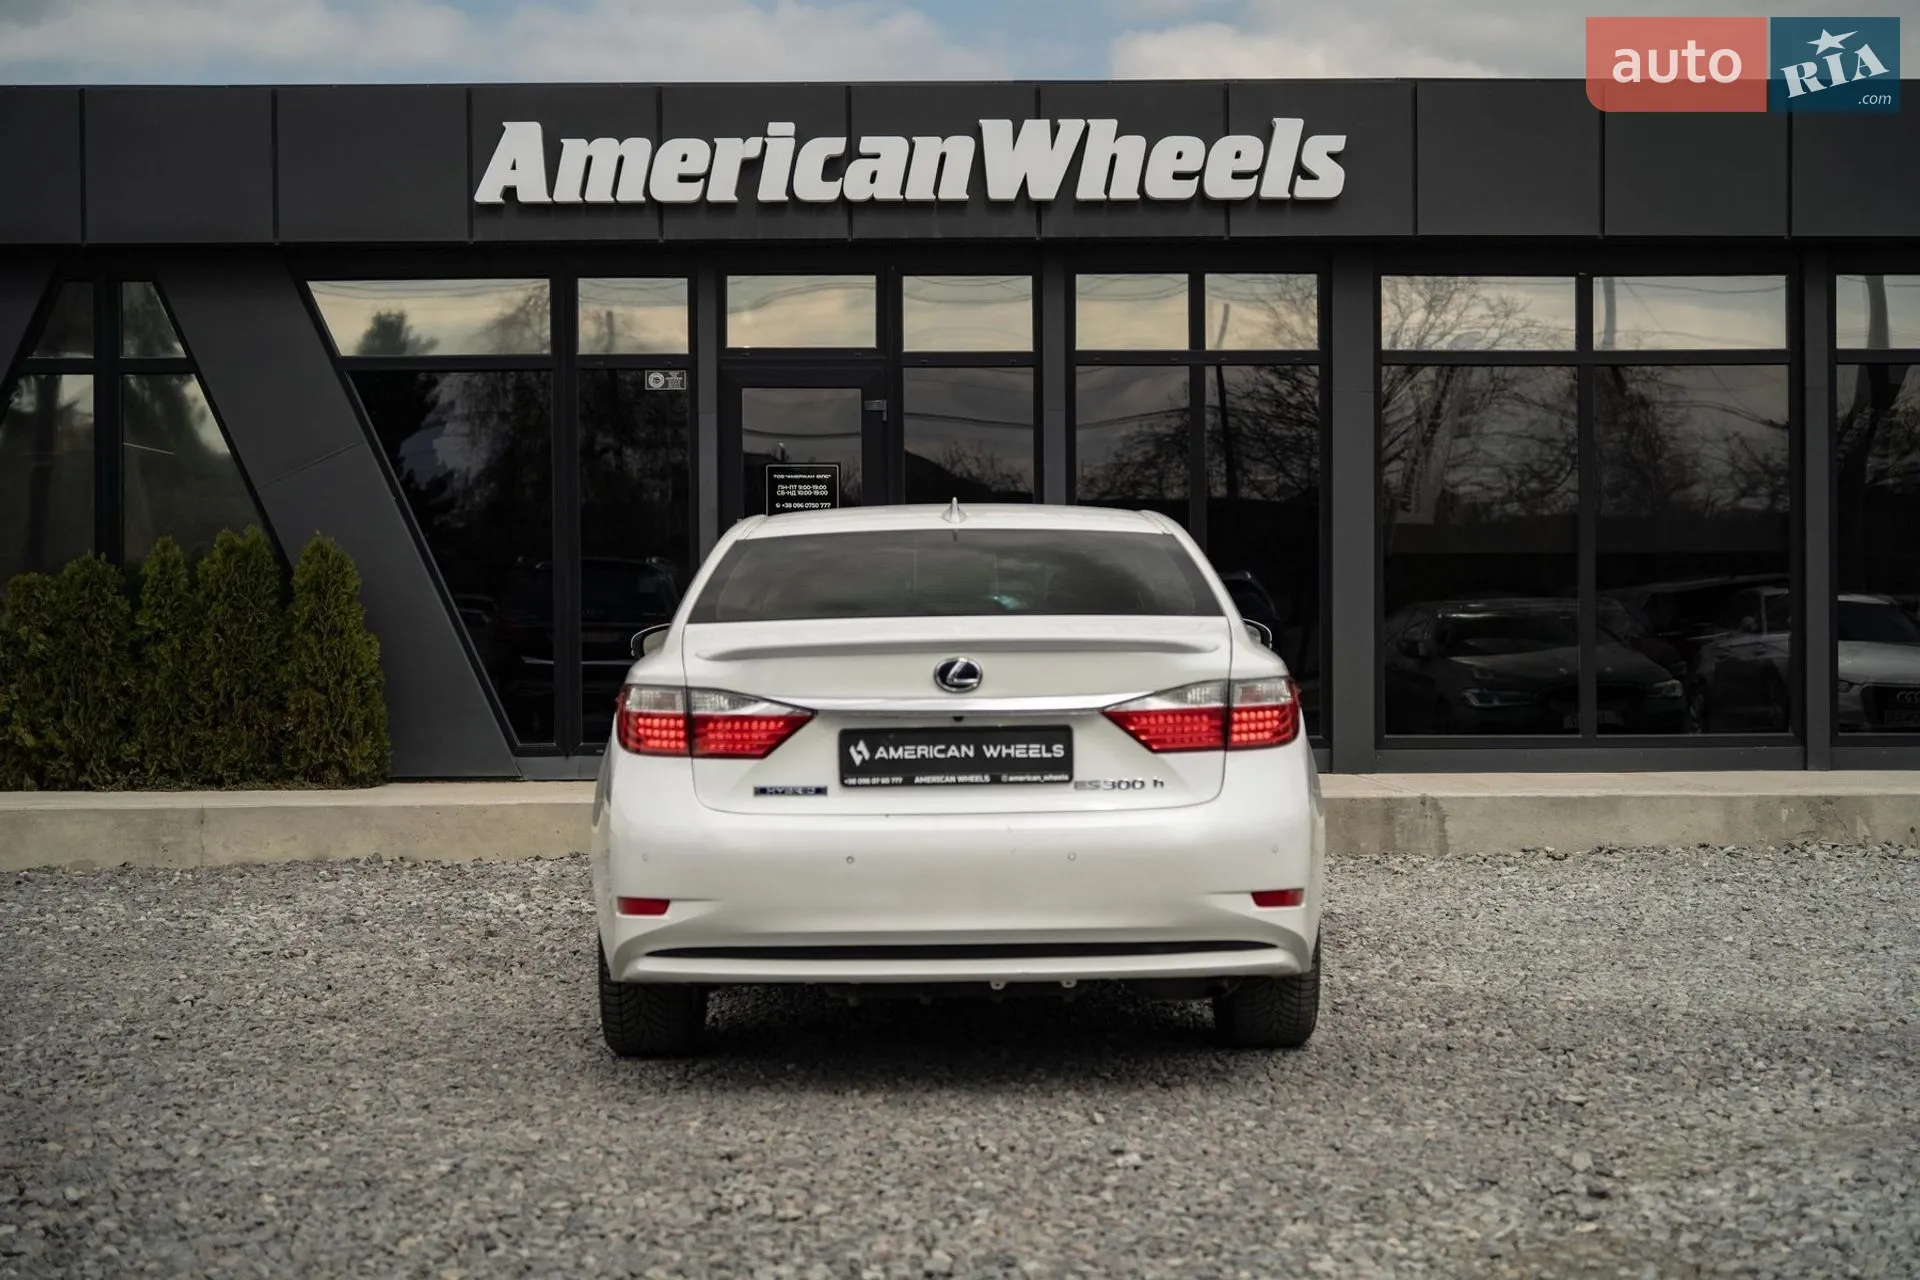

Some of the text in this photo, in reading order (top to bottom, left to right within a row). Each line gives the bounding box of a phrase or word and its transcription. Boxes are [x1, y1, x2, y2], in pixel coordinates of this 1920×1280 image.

[474, 117, 1347, 204] AmericanWheels
[875, 743, 1065, 760] AMERICAN WHEELS
[914, 774, 991, 784] AMERICAN WHEELS
